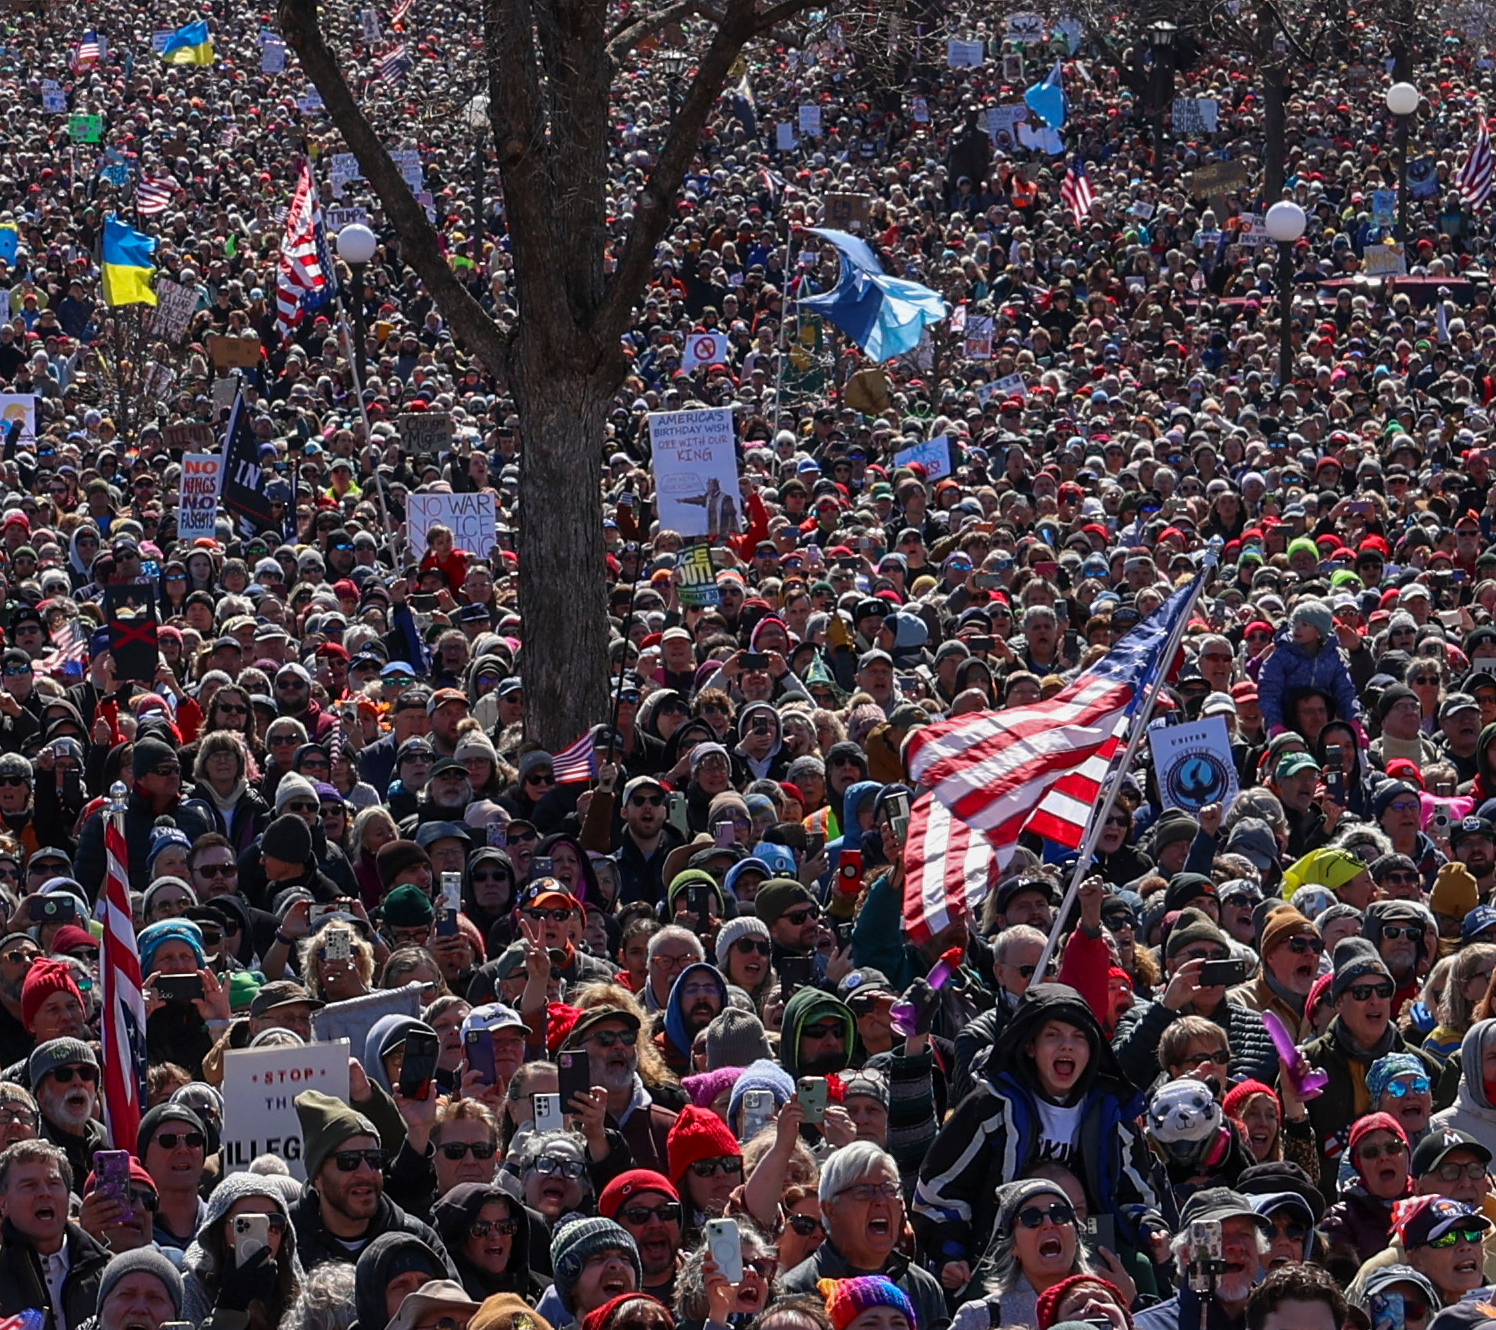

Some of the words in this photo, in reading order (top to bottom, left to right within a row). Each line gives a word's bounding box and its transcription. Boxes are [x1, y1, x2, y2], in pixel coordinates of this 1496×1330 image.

[657, 411, 725, 426] AMERICA'S
[654, 423, 703, 438] BIRTHDAY
[704, 422, 730, 435] WISH
[677, 436, 705, 449] WITH
[706, 435, 728, 446] OUR
[676, 448, 713, 462] KING
[185, 461, 217, 474] NO
[183, 477, 216, 492] KINGS
[182, 496, 215, 509] NO
[408, 496, 443, 517] NO
[447, 493, 491, 515] WAR
[181, 512, 214, 529] FASCISTS
[455, 516, 491, 536] ICE
[677, 549, 708, 567] ICE
[1170, 732, 1209, 747] UNITED
[266, 1069, 314, 1085] STOP
[263, 1098, 294, 1113] TH
[225, 1135, 301, 1167] ILLEG
